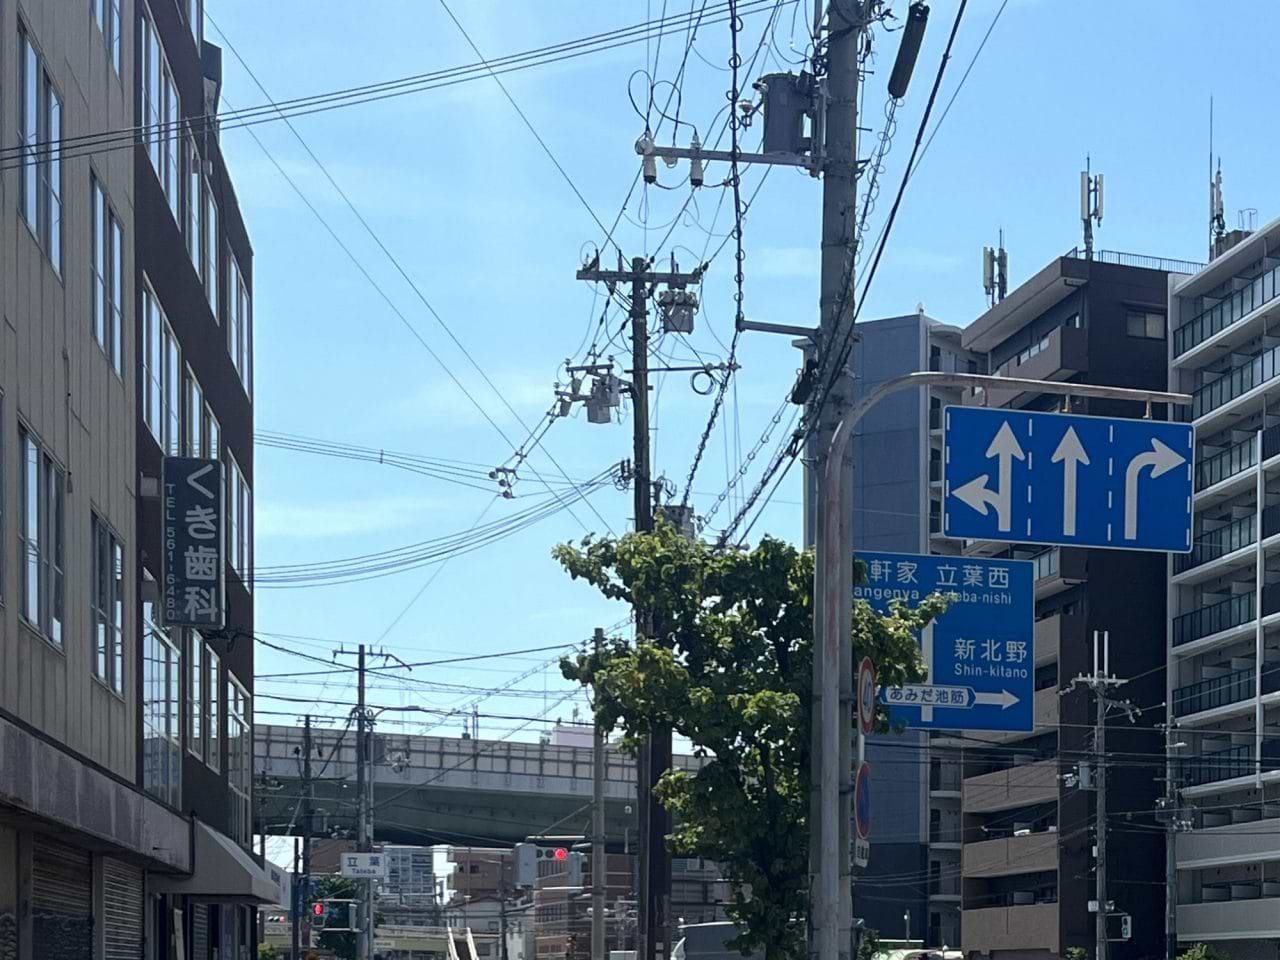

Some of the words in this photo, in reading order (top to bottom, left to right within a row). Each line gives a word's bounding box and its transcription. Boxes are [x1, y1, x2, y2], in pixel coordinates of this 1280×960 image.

[166, 483, 176, 520] TEL
[184, 464, 218, 622] くき歯科
[166, 527, 176, 620] 561-6480
[870, 560, 918, 584] 軒家
[936, 564, 1009, 588] 立葉西
[854, 586, 919, 602] angenya
[954, 638, 1027, 663] 新北野
[954, 662, 1028, 679] Shin-kitano
[890, 686, 964, 704] あみだ池筋
